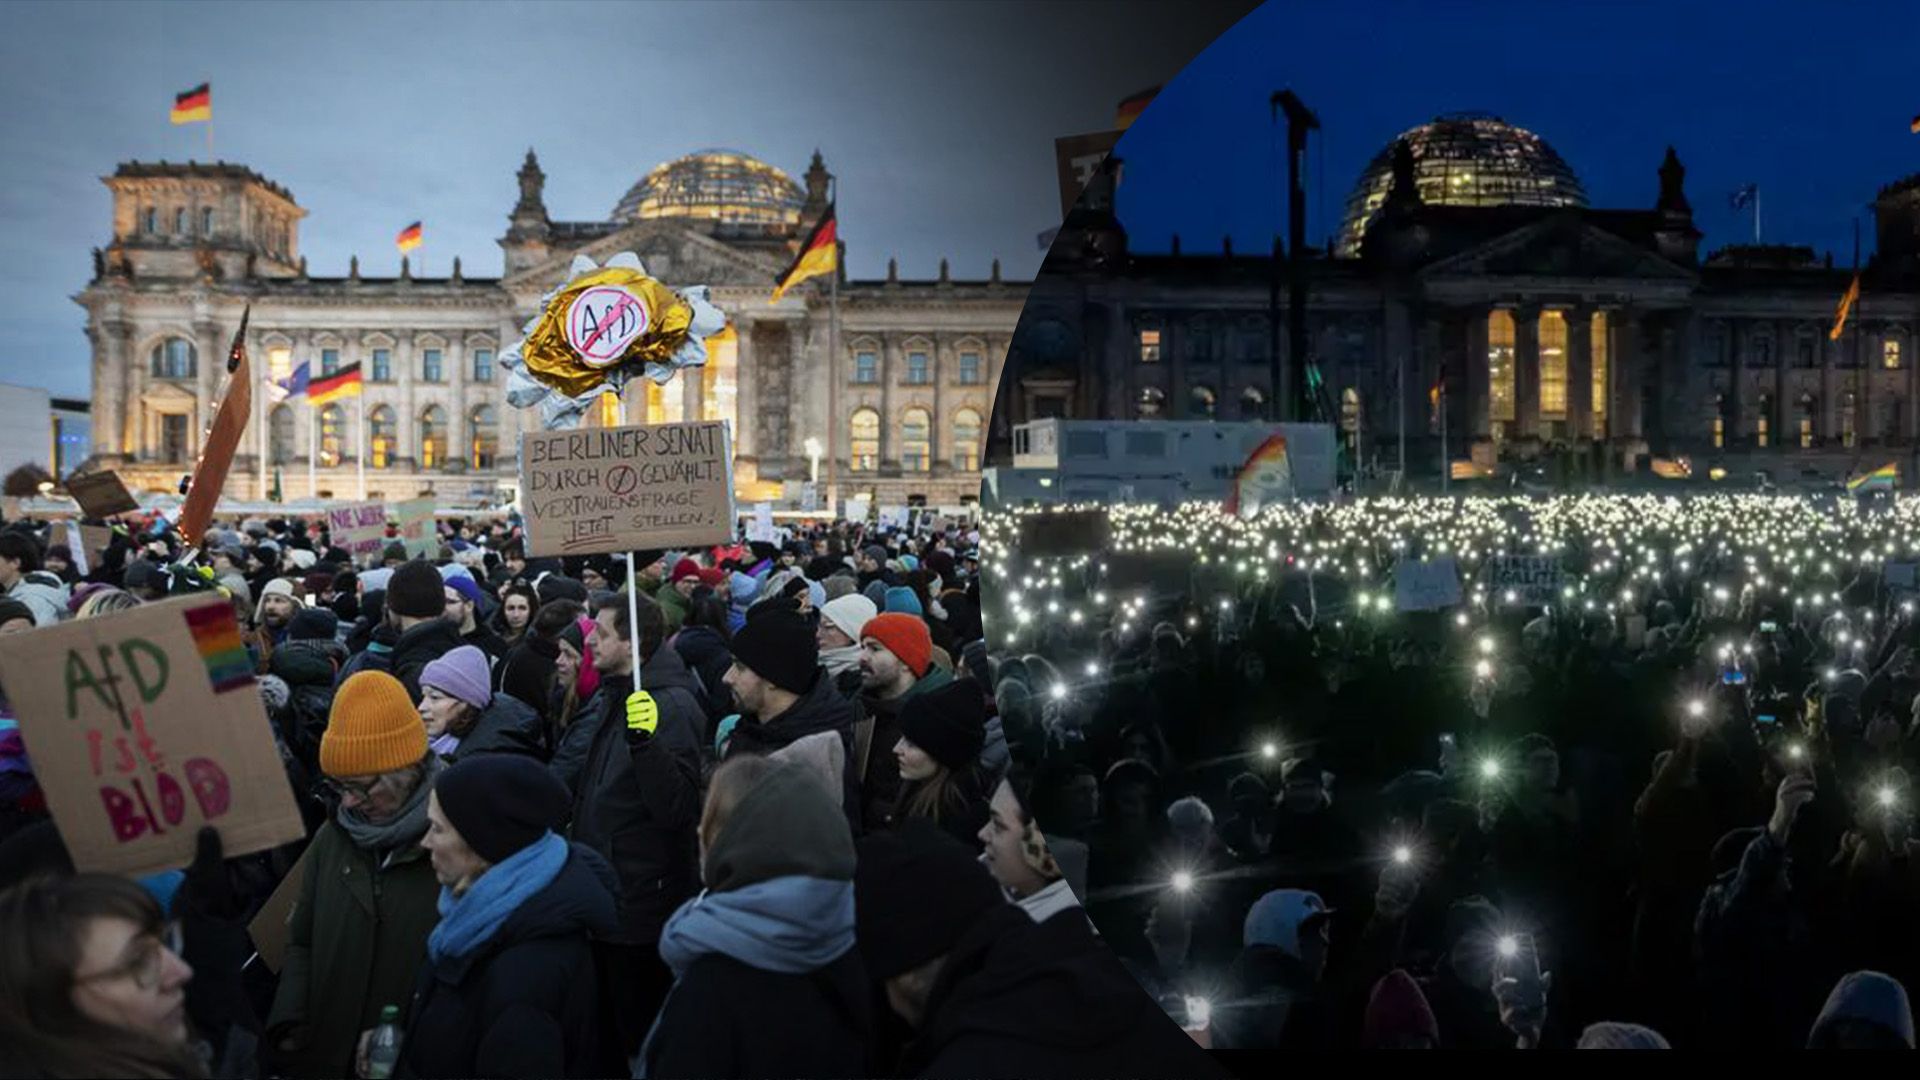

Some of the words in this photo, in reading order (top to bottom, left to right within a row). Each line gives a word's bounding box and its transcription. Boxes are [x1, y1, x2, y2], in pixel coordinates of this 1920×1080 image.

[582, 304, 636, 344] AfD
[531, 430, 650, 463] BERLINER
[655, 425, 718, 456] SENAT
[531, 467, 600, 492] DURCH
[532, 489, 706, 519] VERTRAUENSFRAGE
[65, 638, 170, 730] AfD
